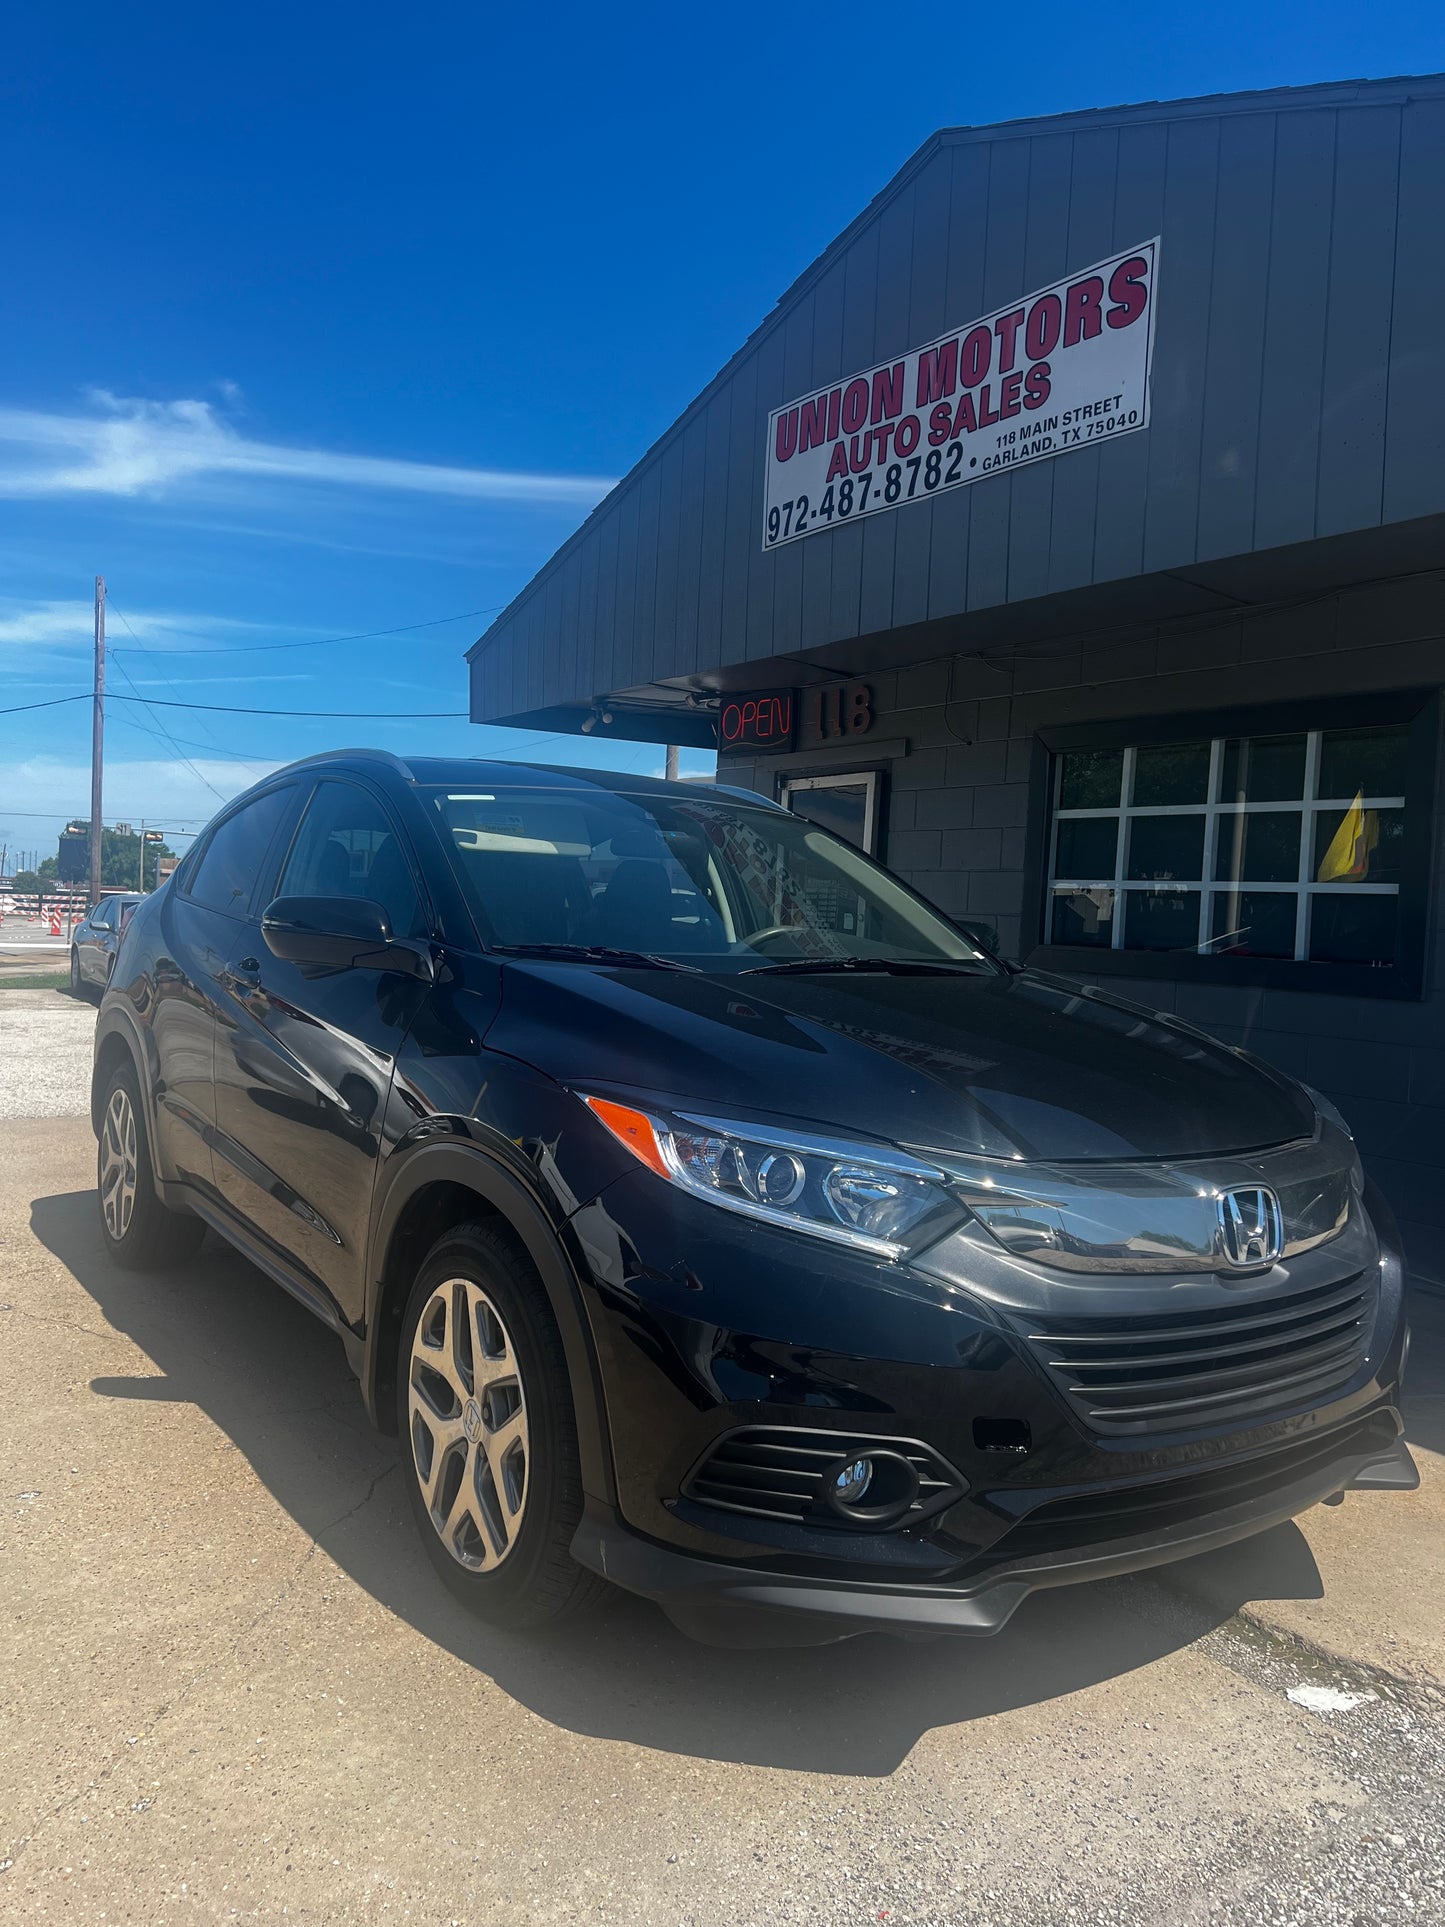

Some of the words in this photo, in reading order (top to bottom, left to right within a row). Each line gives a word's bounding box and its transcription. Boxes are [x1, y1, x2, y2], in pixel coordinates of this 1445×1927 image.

[775, 361, 905, 463] UNION
[916, 256, 1149, 409] MOTORS
[826, 414, 921, 483] AUTO
[928, 361, 1052, 447] SALES
[982, 436, 1057, 471] GARLAND,
[1061, 426, 1081, 445] TX
[1087, 410, 1138, 437] 75040
[996, 431, 1016, 449] 118
[1019, 415, 1058, 441] MAIN
[1062, 394, 1123, 427] STREET
[768, 441, 964, 543] 972-487-8782
[721, 696, 791, 740] OPEN
[815, 685, 872, 742] 118
